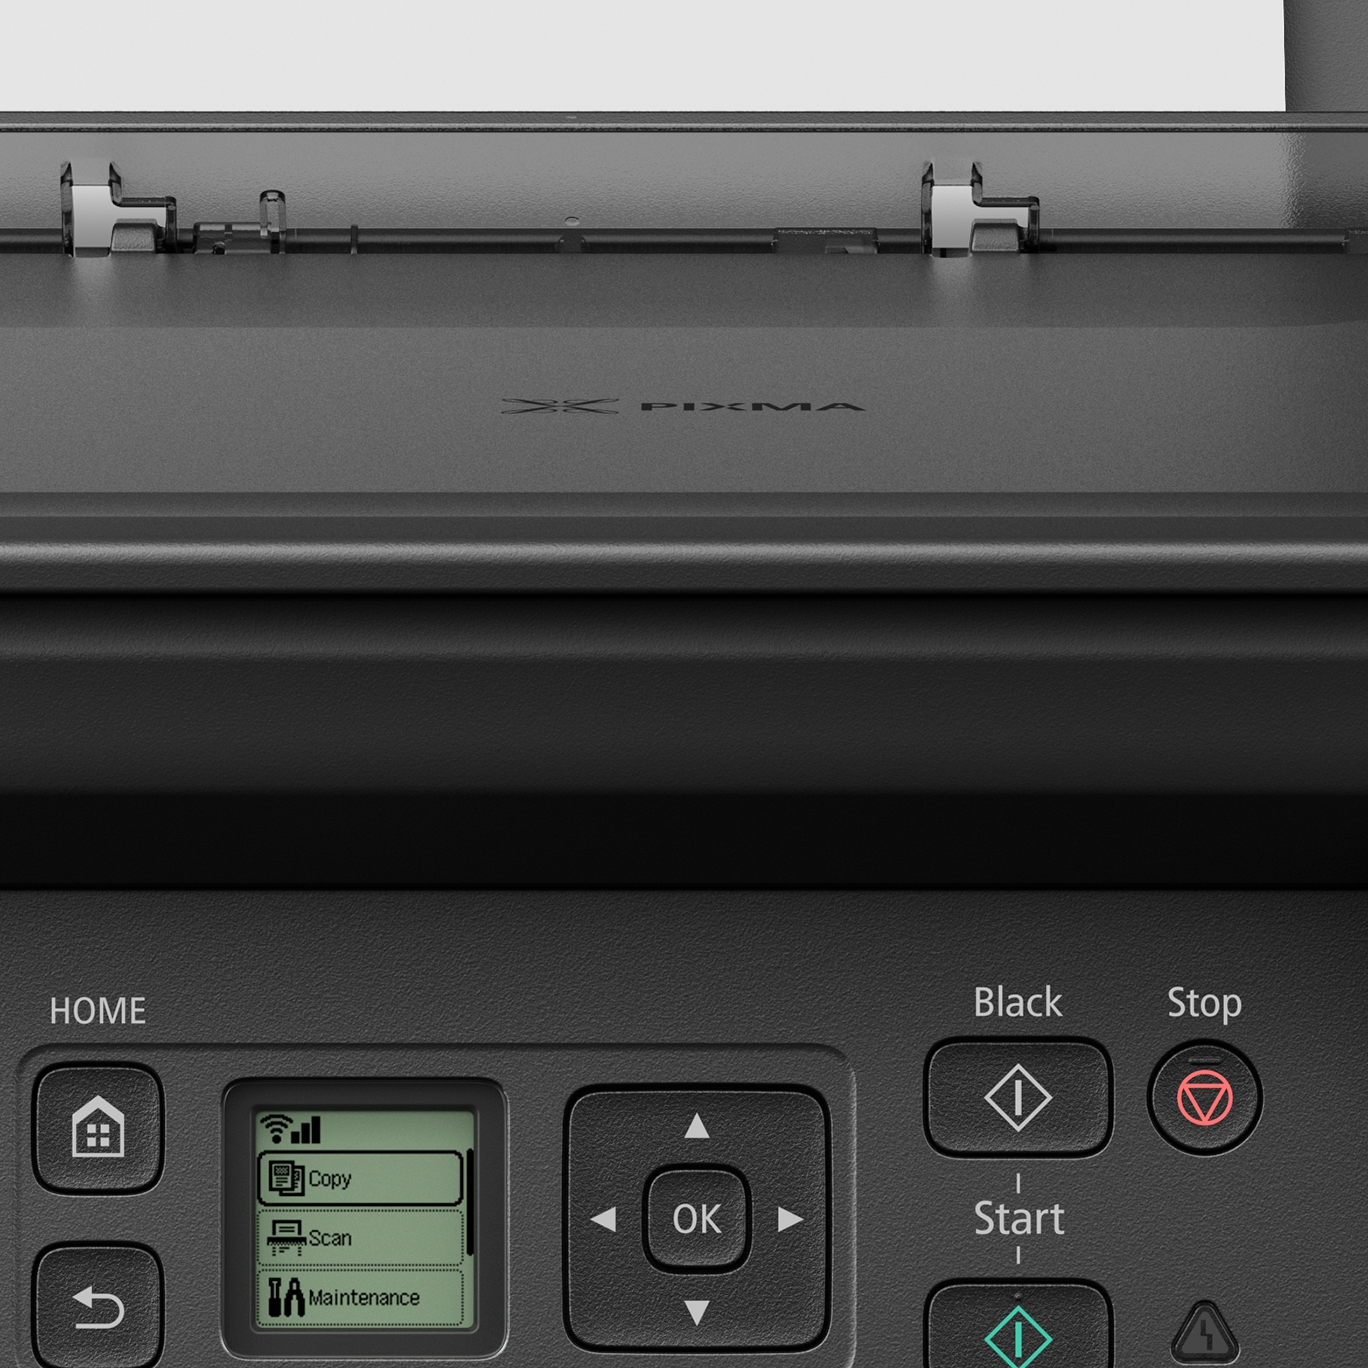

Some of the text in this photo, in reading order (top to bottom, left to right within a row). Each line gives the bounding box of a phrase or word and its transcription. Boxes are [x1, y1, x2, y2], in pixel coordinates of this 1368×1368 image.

[640, 402, 866, 412] PIXMA
[50, 996, 146, 1025] HOME
[975, 984, 1064, 1018] Black
[1168, 986, 1242, 1026] Stop
[309, 1169, 352, 1191] Copy
[673, 1203, 722, 1235] OK
[974, 1200, 1065, 1235] Start
[308, 1229, 352, 1247] Scan
[309, 1289, 420, 1306] Maintenance
